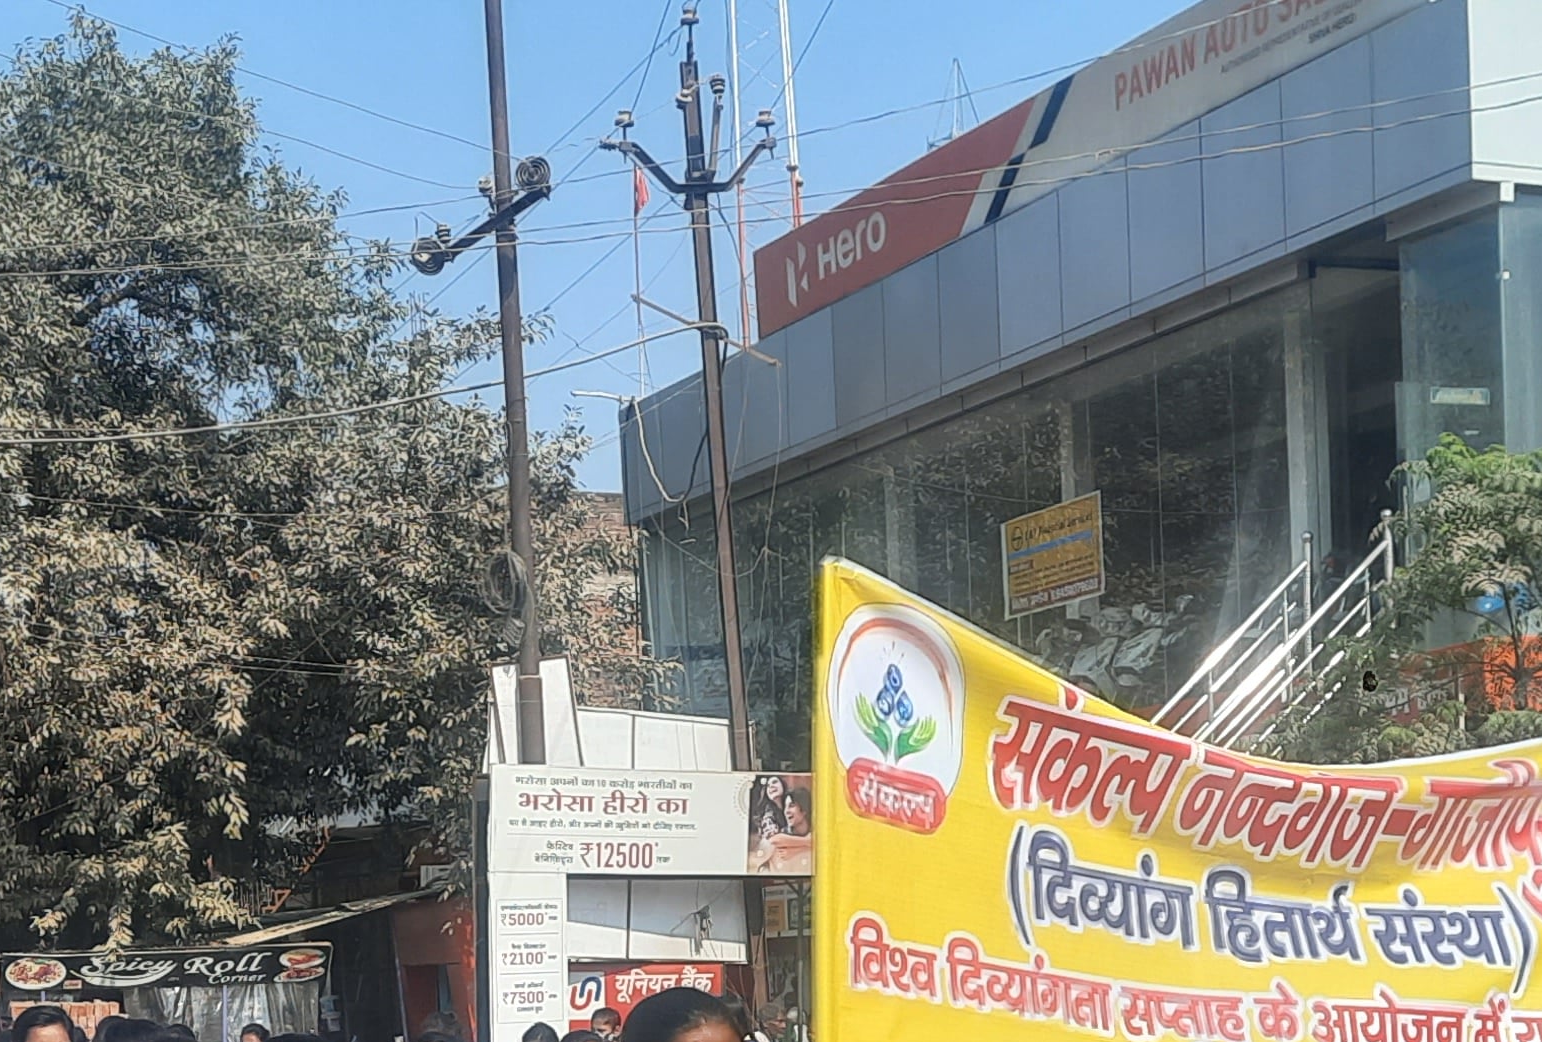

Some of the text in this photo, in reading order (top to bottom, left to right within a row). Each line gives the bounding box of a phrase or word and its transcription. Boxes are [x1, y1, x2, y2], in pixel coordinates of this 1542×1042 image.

[1115, 1, 1269, 111] PAWAN AUTO
[518, 789, 690, 815] भरोसा हीरो का
[1010, 825, 1532, 993] (दिव्यांग हितार्थ संस्था)
[80, 952, 272, 981] Spicy Roll
[209, 973, 264, 985] Corner
[615, 965, 714, 1004] यूनियन बैंक
[850, 917, 937, 996] विश्व
[947, 938, 1111, 1031] दिव्यांगता
[1120, 985, 1245, 1042] सप्ताह
[1254, 983, 1300, 1042] के
